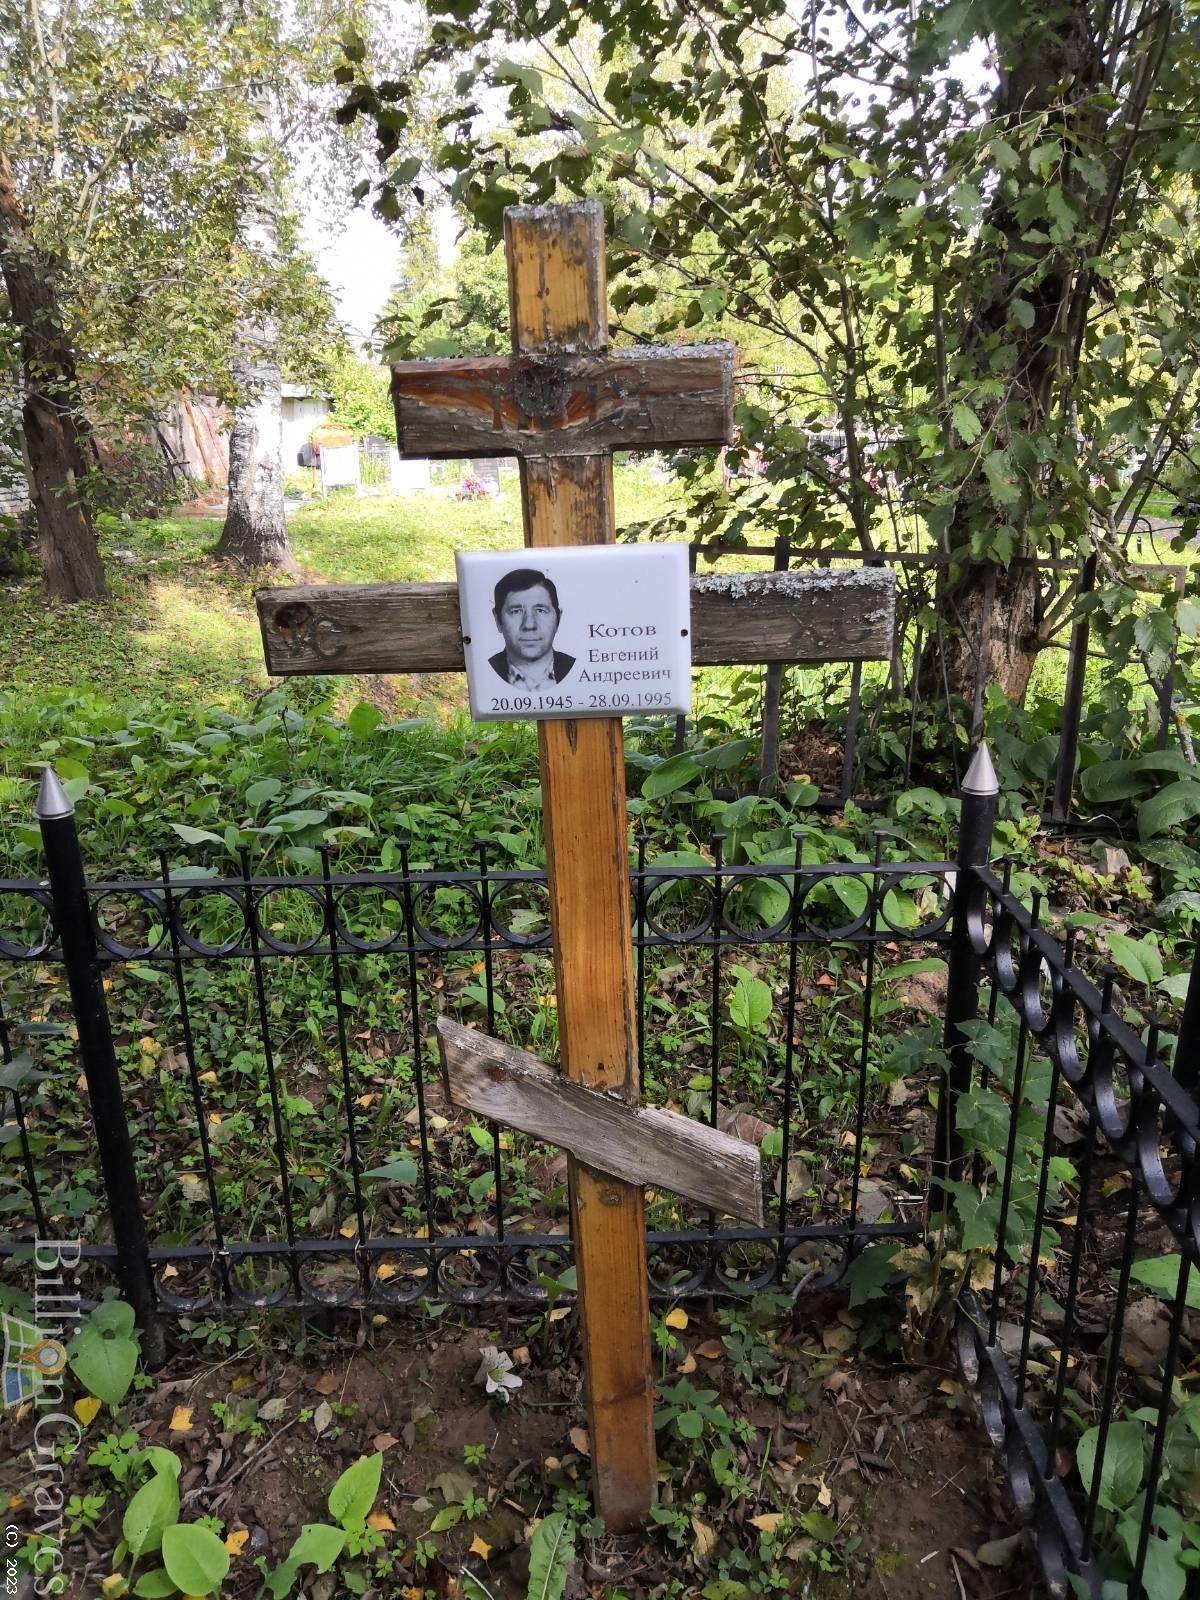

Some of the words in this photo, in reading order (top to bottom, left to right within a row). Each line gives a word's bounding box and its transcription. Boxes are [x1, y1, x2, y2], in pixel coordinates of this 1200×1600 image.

[588, 623, 657, 638] Котов
[588, 647, 659, 663] Евгений
[578, 668, 672, 685] Андреевич
[491, 695, 573, 711] 20.09.1945
[588, 692, 672, 708] 28.09.1995
